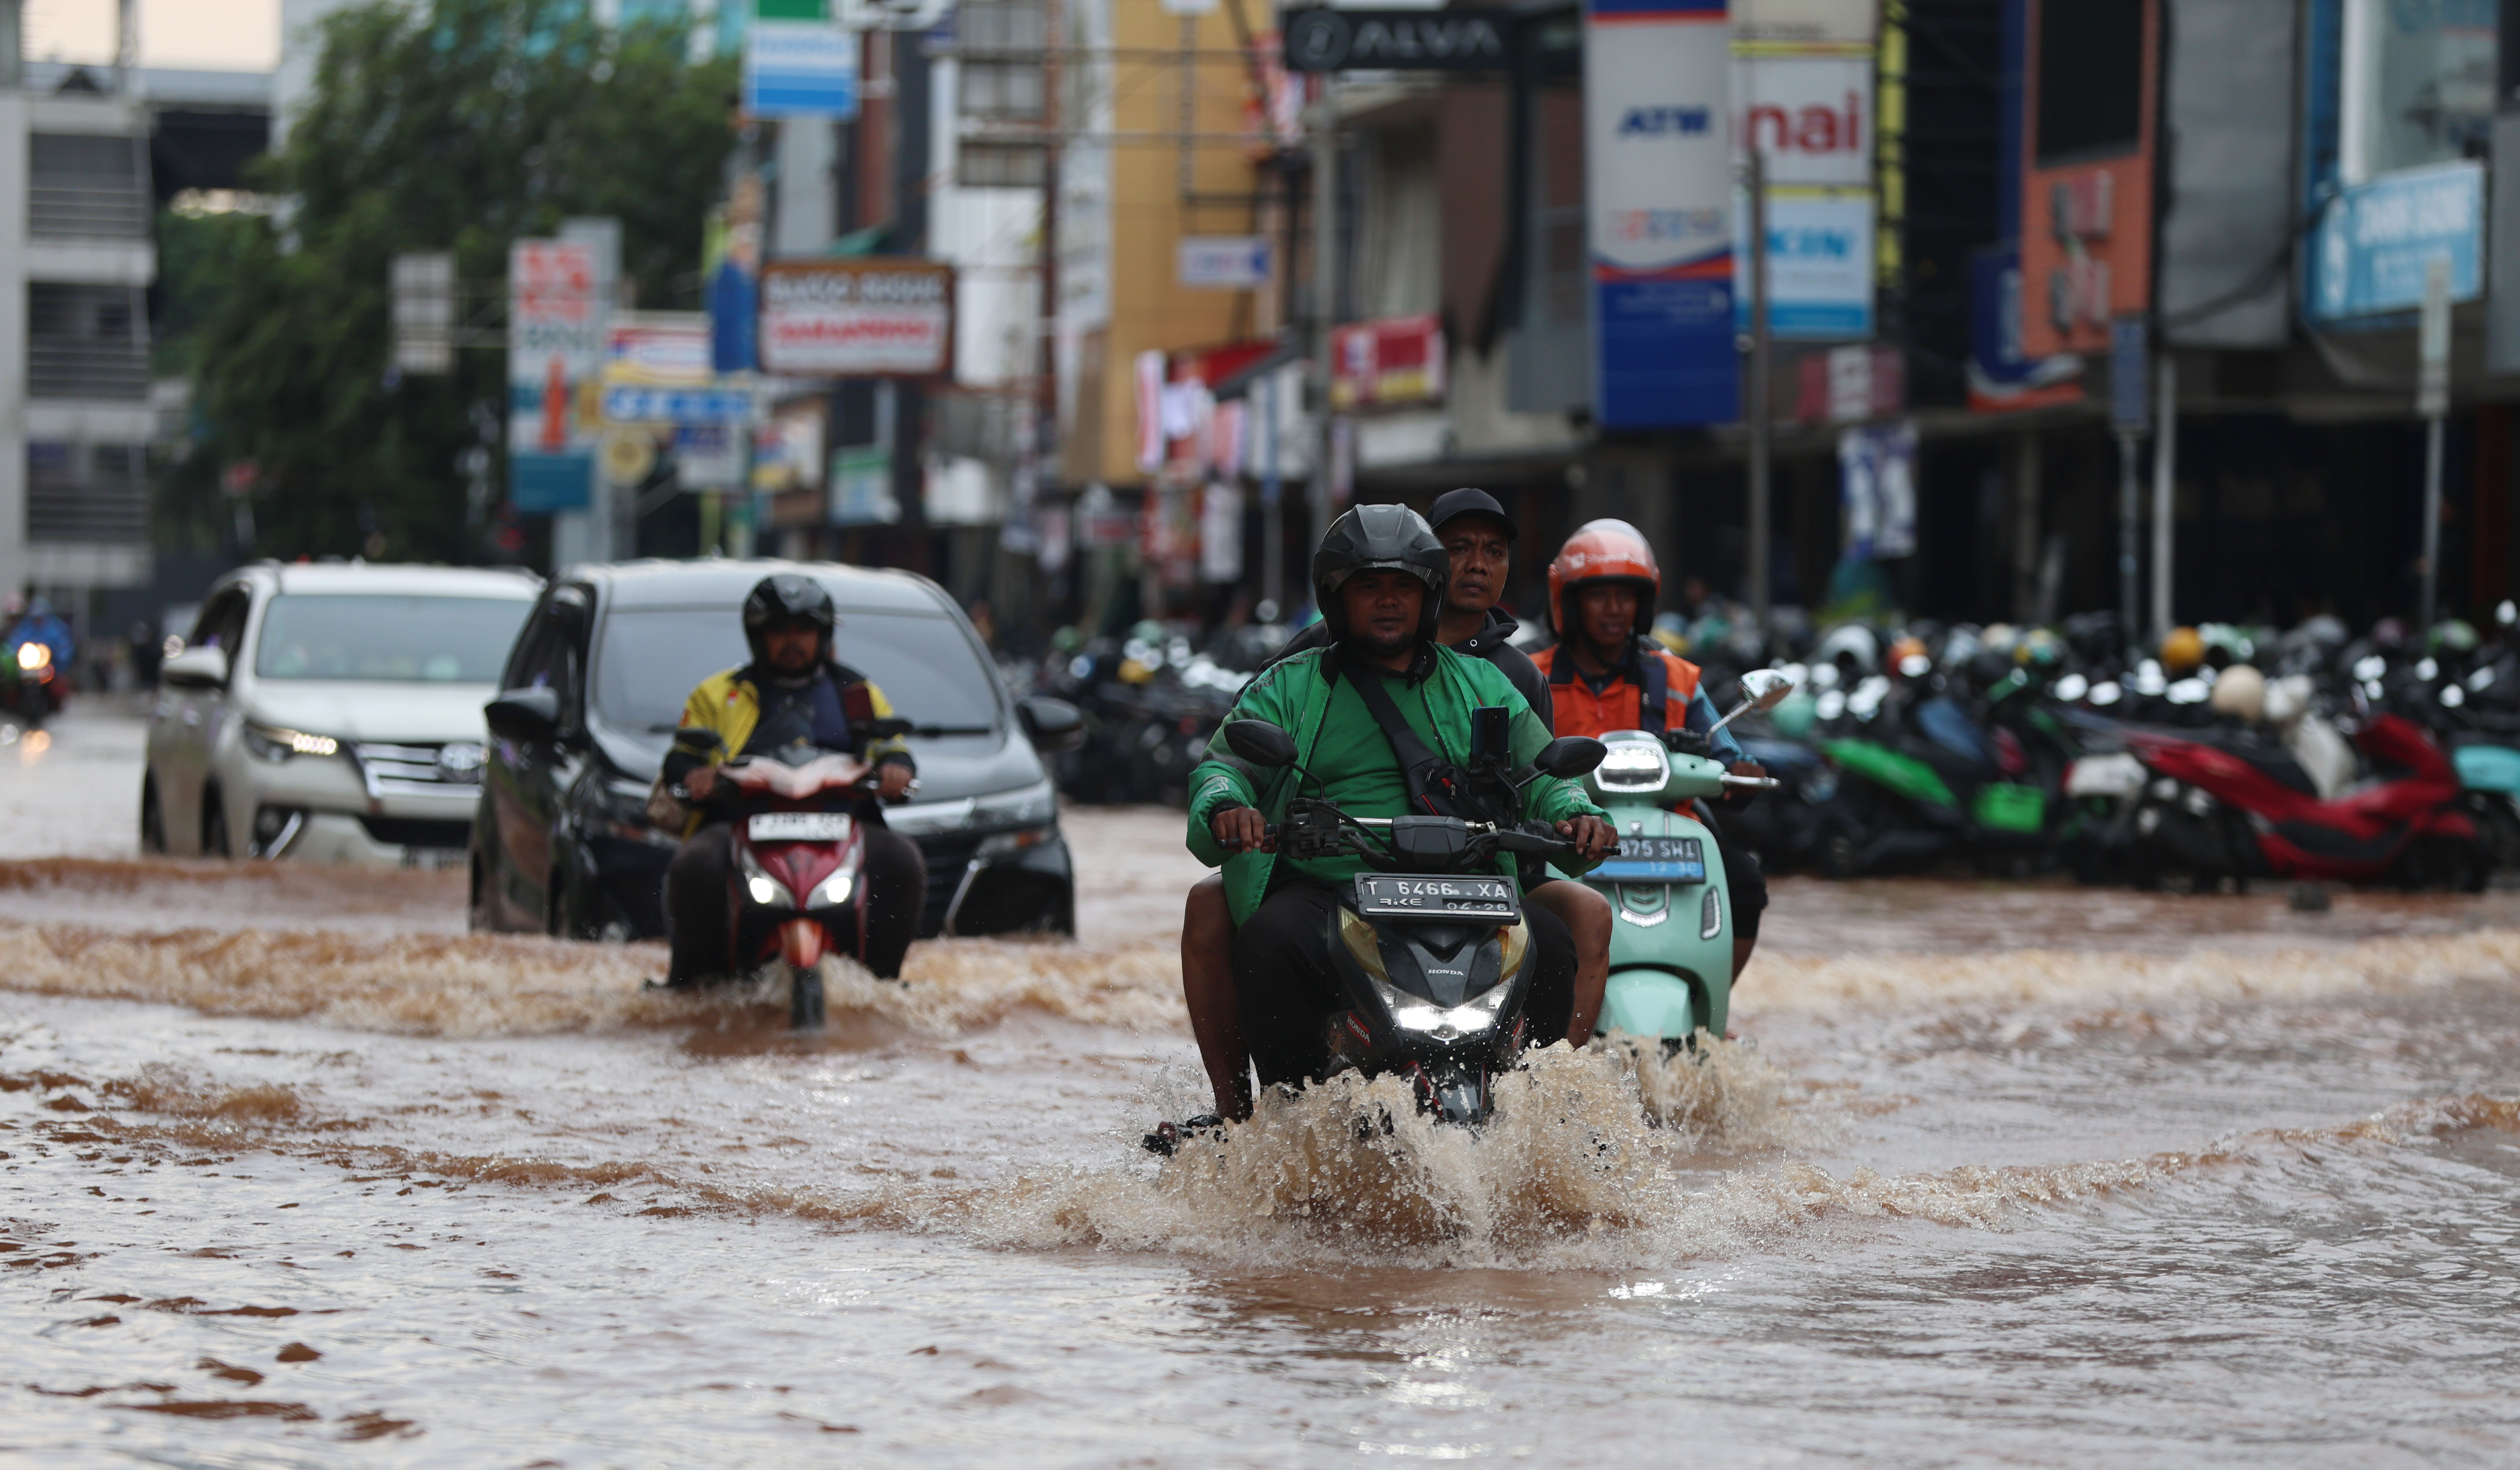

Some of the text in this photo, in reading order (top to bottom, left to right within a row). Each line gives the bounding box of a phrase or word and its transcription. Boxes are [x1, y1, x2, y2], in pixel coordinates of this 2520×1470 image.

[1352, 18, 1502, 58] ALVA
[1621, 105, 1711, 135] ATM
[1730, 90, 1859, 155] nai
[1366, 881, 1508, 898] T 6466 XA
[1347, 1015, 1371, 1043] HONDA
